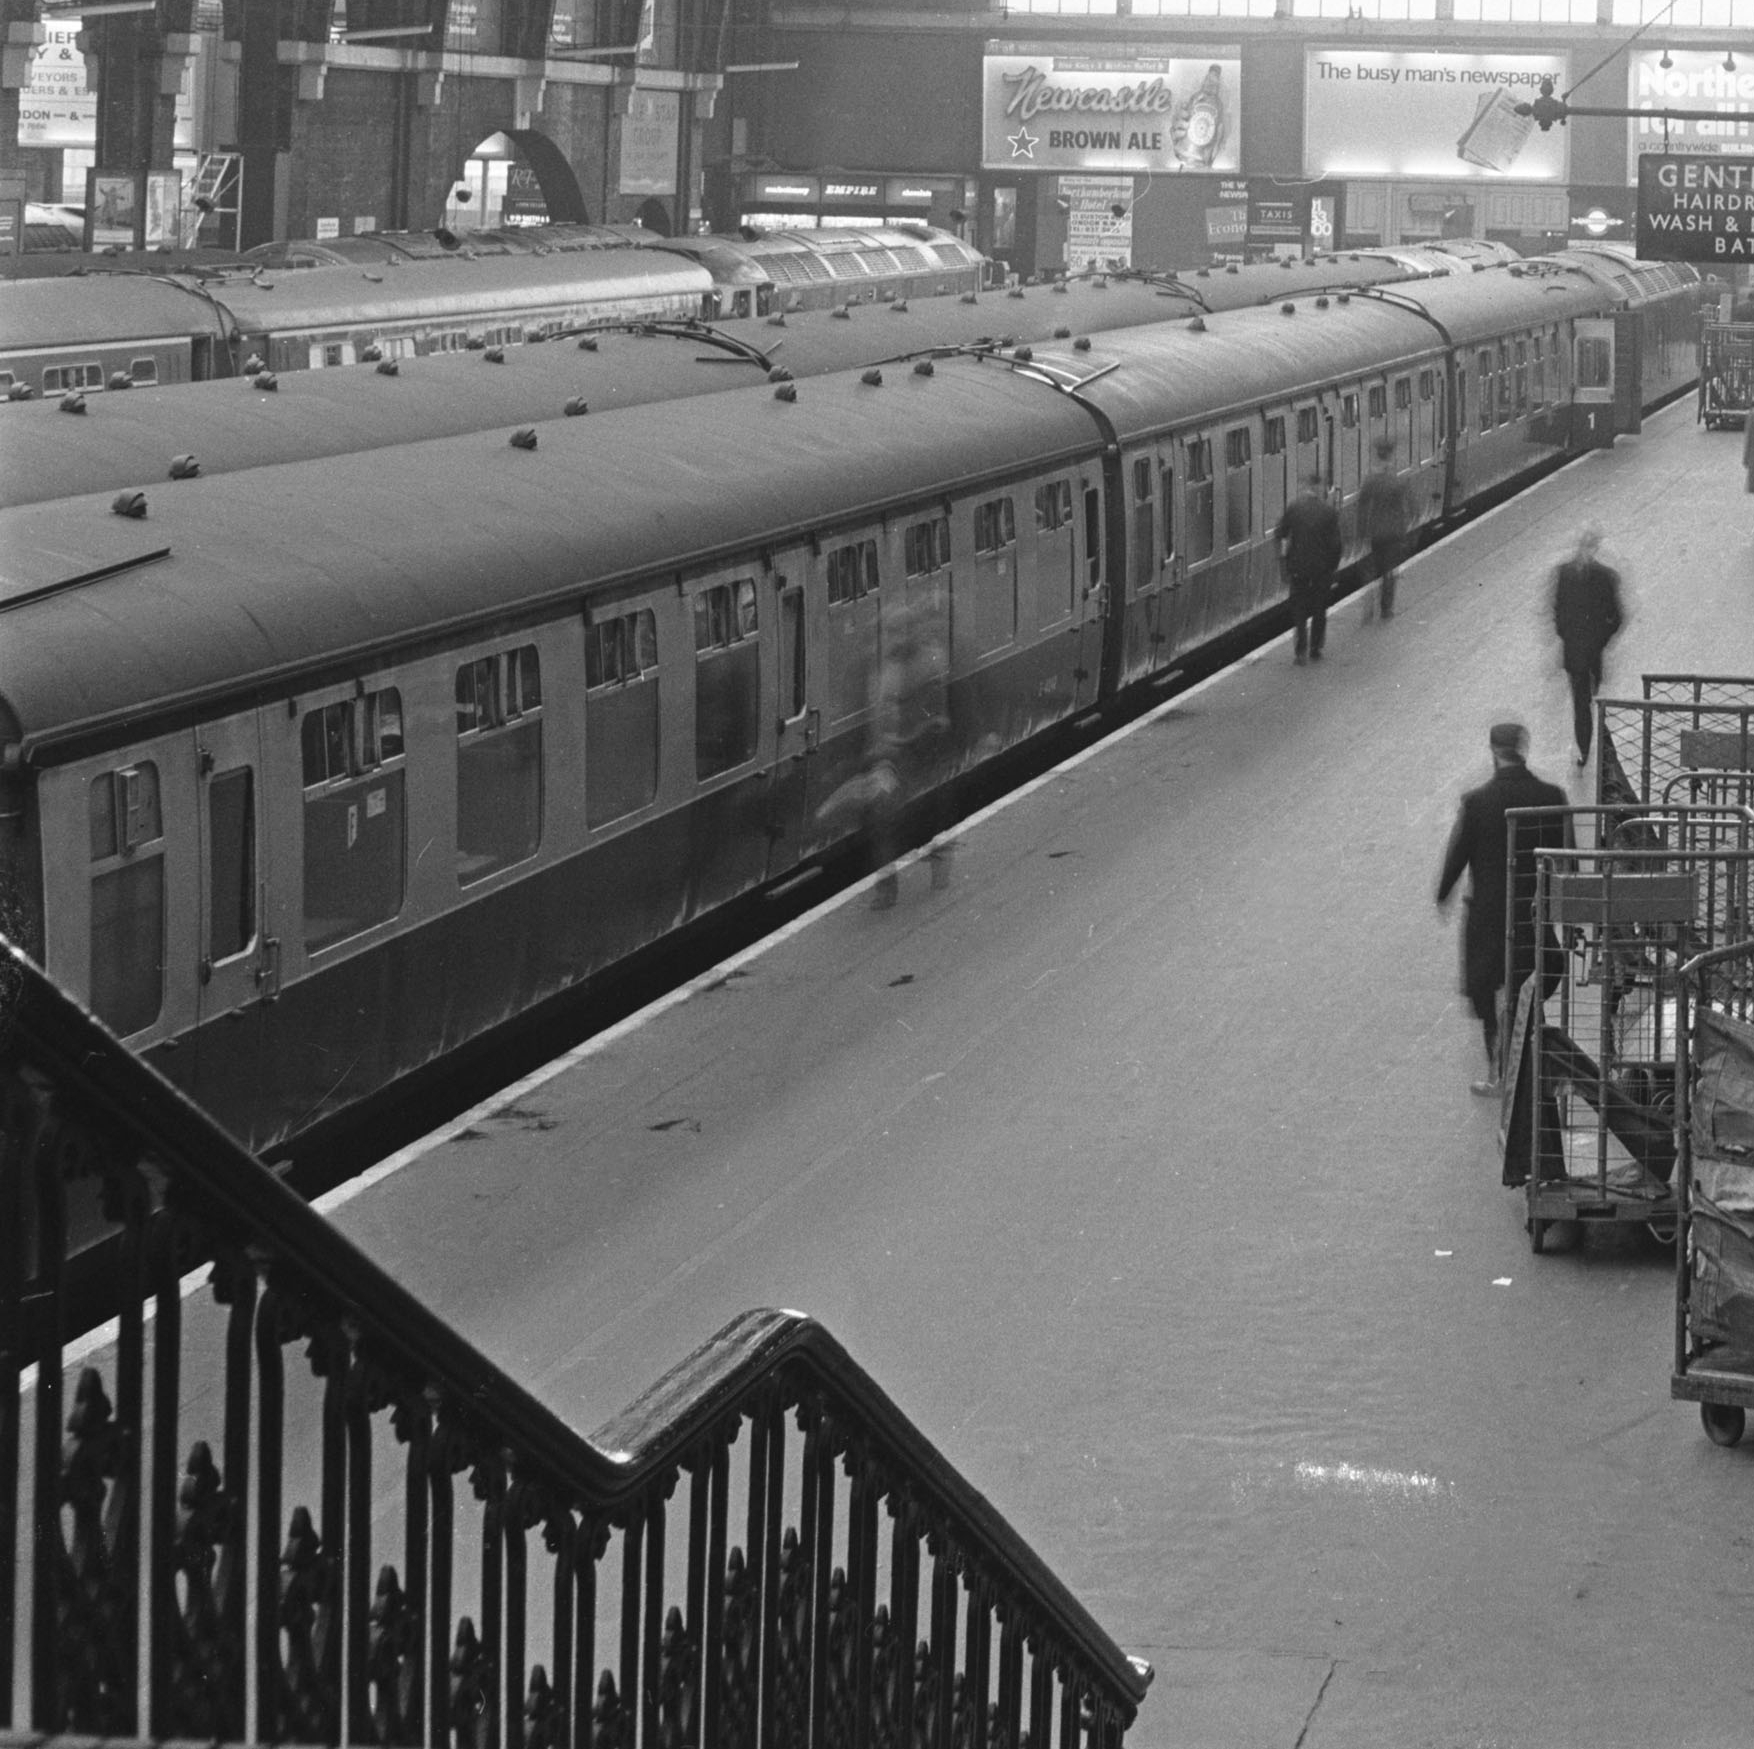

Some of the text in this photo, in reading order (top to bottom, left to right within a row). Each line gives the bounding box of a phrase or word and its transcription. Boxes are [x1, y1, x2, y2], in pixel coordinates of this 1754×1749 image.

[59, 48, 72, 60] &
[1317, 61, 1561, 88] The busy man's newspaper
[1002, 65, 1172, 121] Newcastle
[1638, 102, 1750, 137] for all!
[1049, 130, 1162, 151] BROWN ALE
[825, 184, 878, 196] EMPIRE
[1261, 210, 1292, 219] TAXIS
[1649, 213, 1712, 231] WASH
[1725, 216, 1739, 232] &
[1587, 412, 1595, 430] 1
